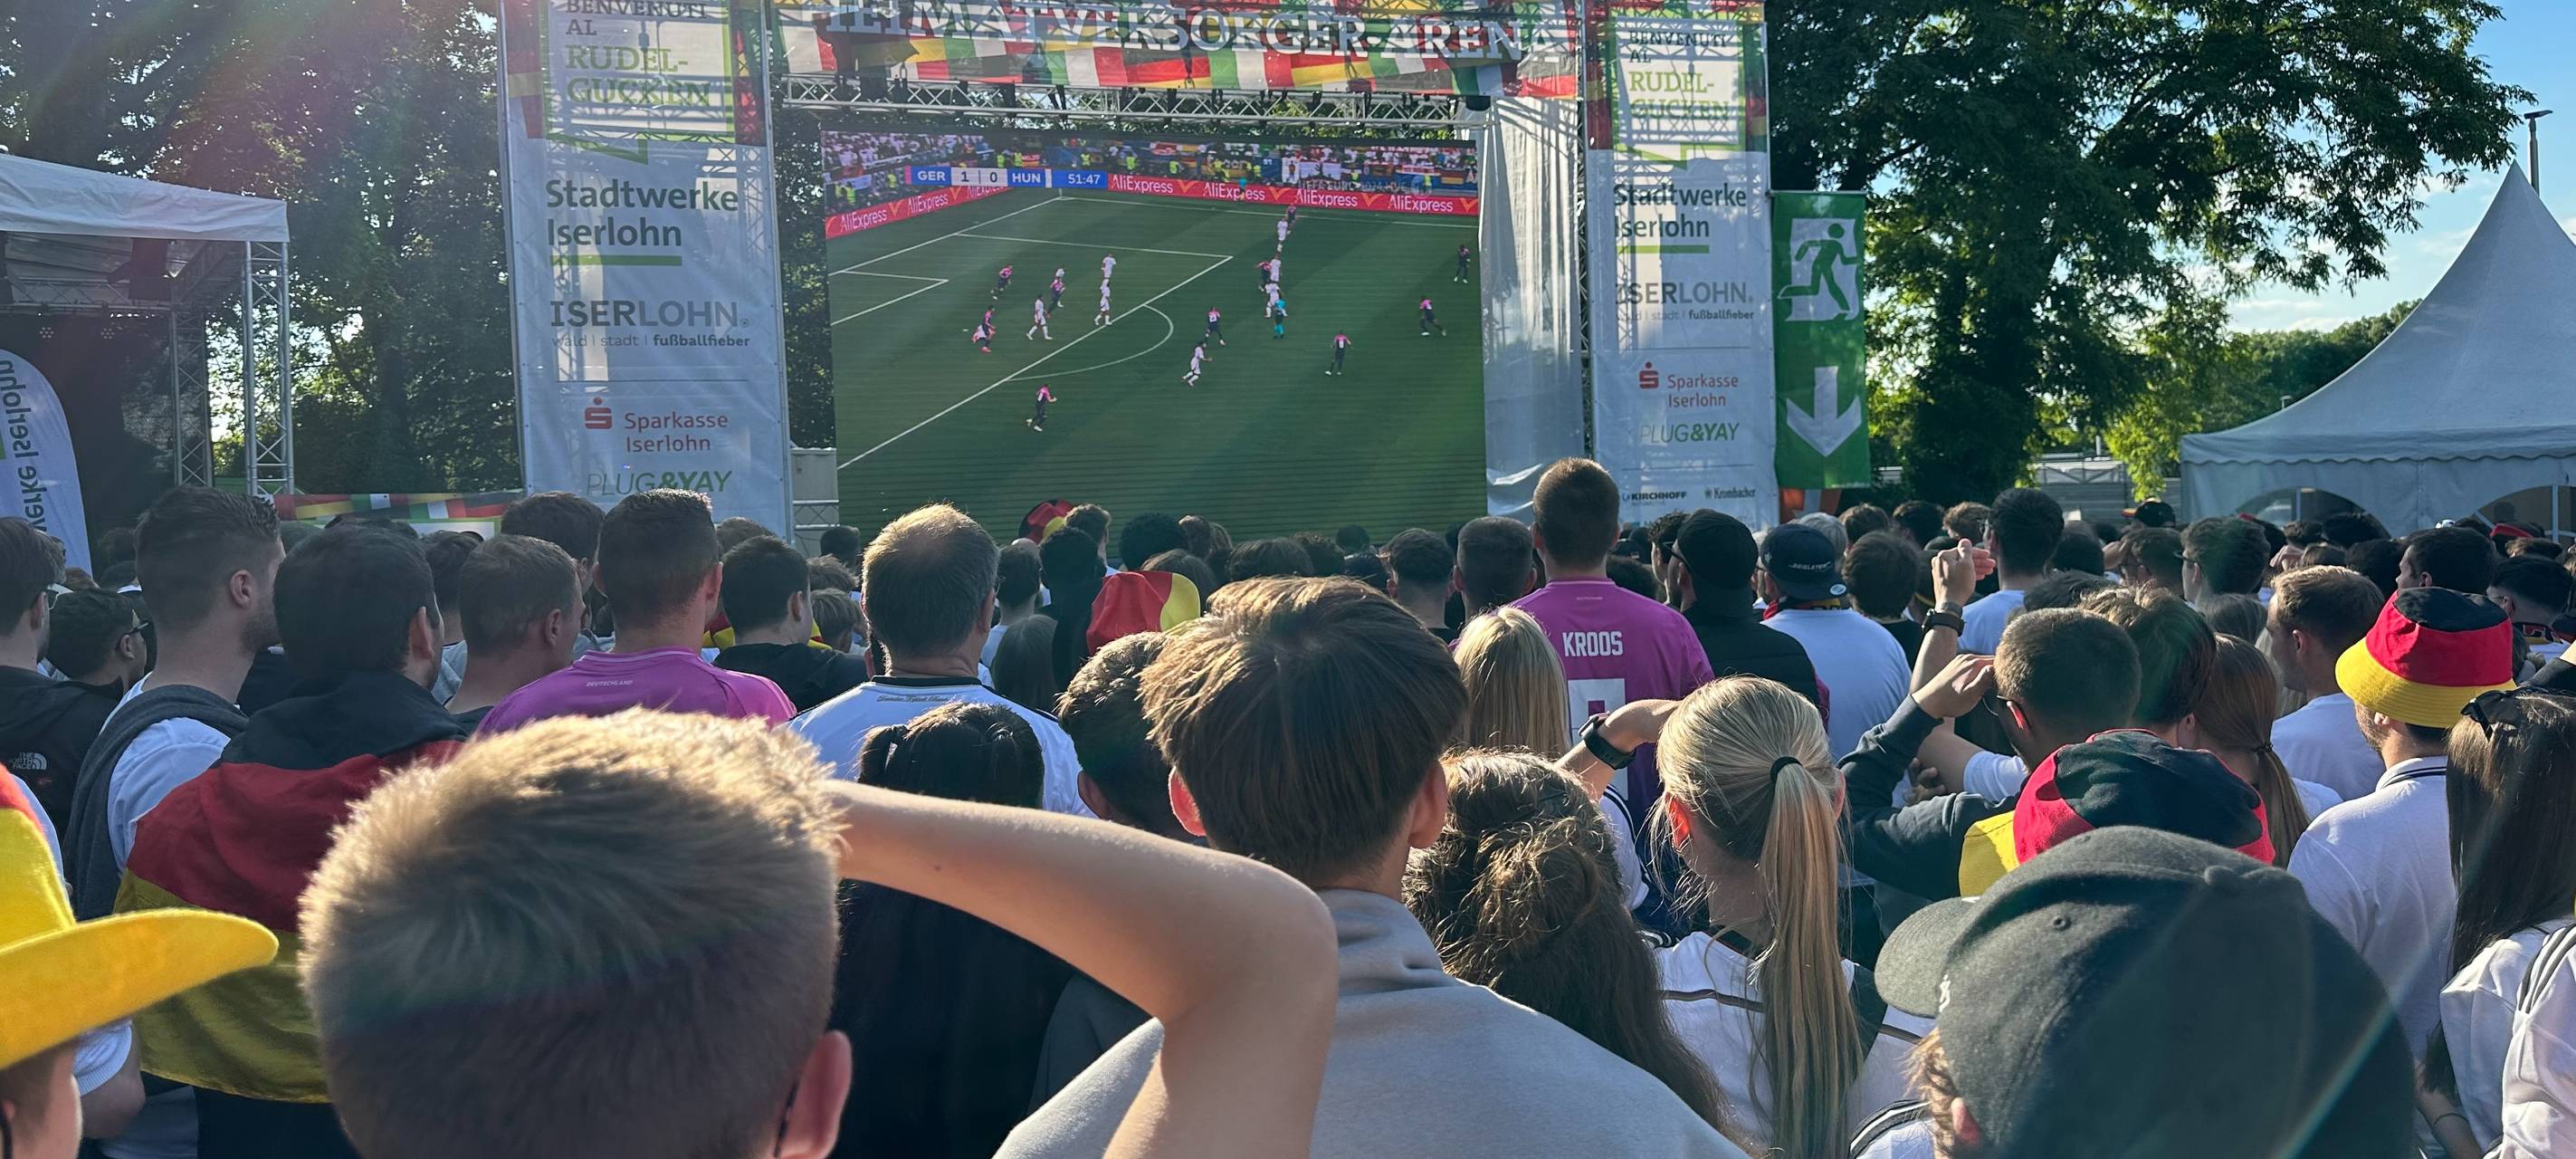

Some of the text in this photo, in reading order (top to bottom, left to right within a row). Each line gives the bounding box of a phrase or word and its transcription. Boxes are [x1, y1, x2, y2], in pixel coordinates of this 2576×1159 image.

[566, 19, 597, 35] AL
[565, 45, 688, 72] RUDEL-
[1629, 49, 1651, 63] AL
[567, 77, 710, 107] GUCKEN
[1629, 72, 1714, 93] RUDEL-
[1629, 99, 1729, 120] GUCKEN
[917, 170, 1101, 185] GER 1 0 HUN 51:47
[1111, 174, 1173, 195] AliExpress
[546, 178, 739, 212] Stadtwerke
[907, 193, 949, 216] AliExpress
[1296, 188, 1358, 207] AliExpress
[1388, 194, 1453, 213] AliExpress
[1613, 183, 1747, 207] Stadtwerke
[840, 208, 888, 233] AliExpress
[1616, 214, 1709, 238] Iserlohn
[548, 217, 682, 246] Iserlohn
[1689, 309, 1754, 320] fußballfieber
[552, 333, 750, 347] wald stadt fußballfieber
[1667, 374, 1738, 391] Sparkasse
[1668, 392, 1726, 407] Iserlohn
[625, 412, 728, 433] Sparkasse
[626, 435, 711, 453] Iserlohn
[1638, 423, 1740, 444] PLUG&YAY
[587, 471, 732, 495] PLUG&YAY
[1714, 487, 1756, 498] Krombacher
[1631, 492, 1687, 501] KIRCHHOFF
[1562, 631, 1623, 657] KROOS
